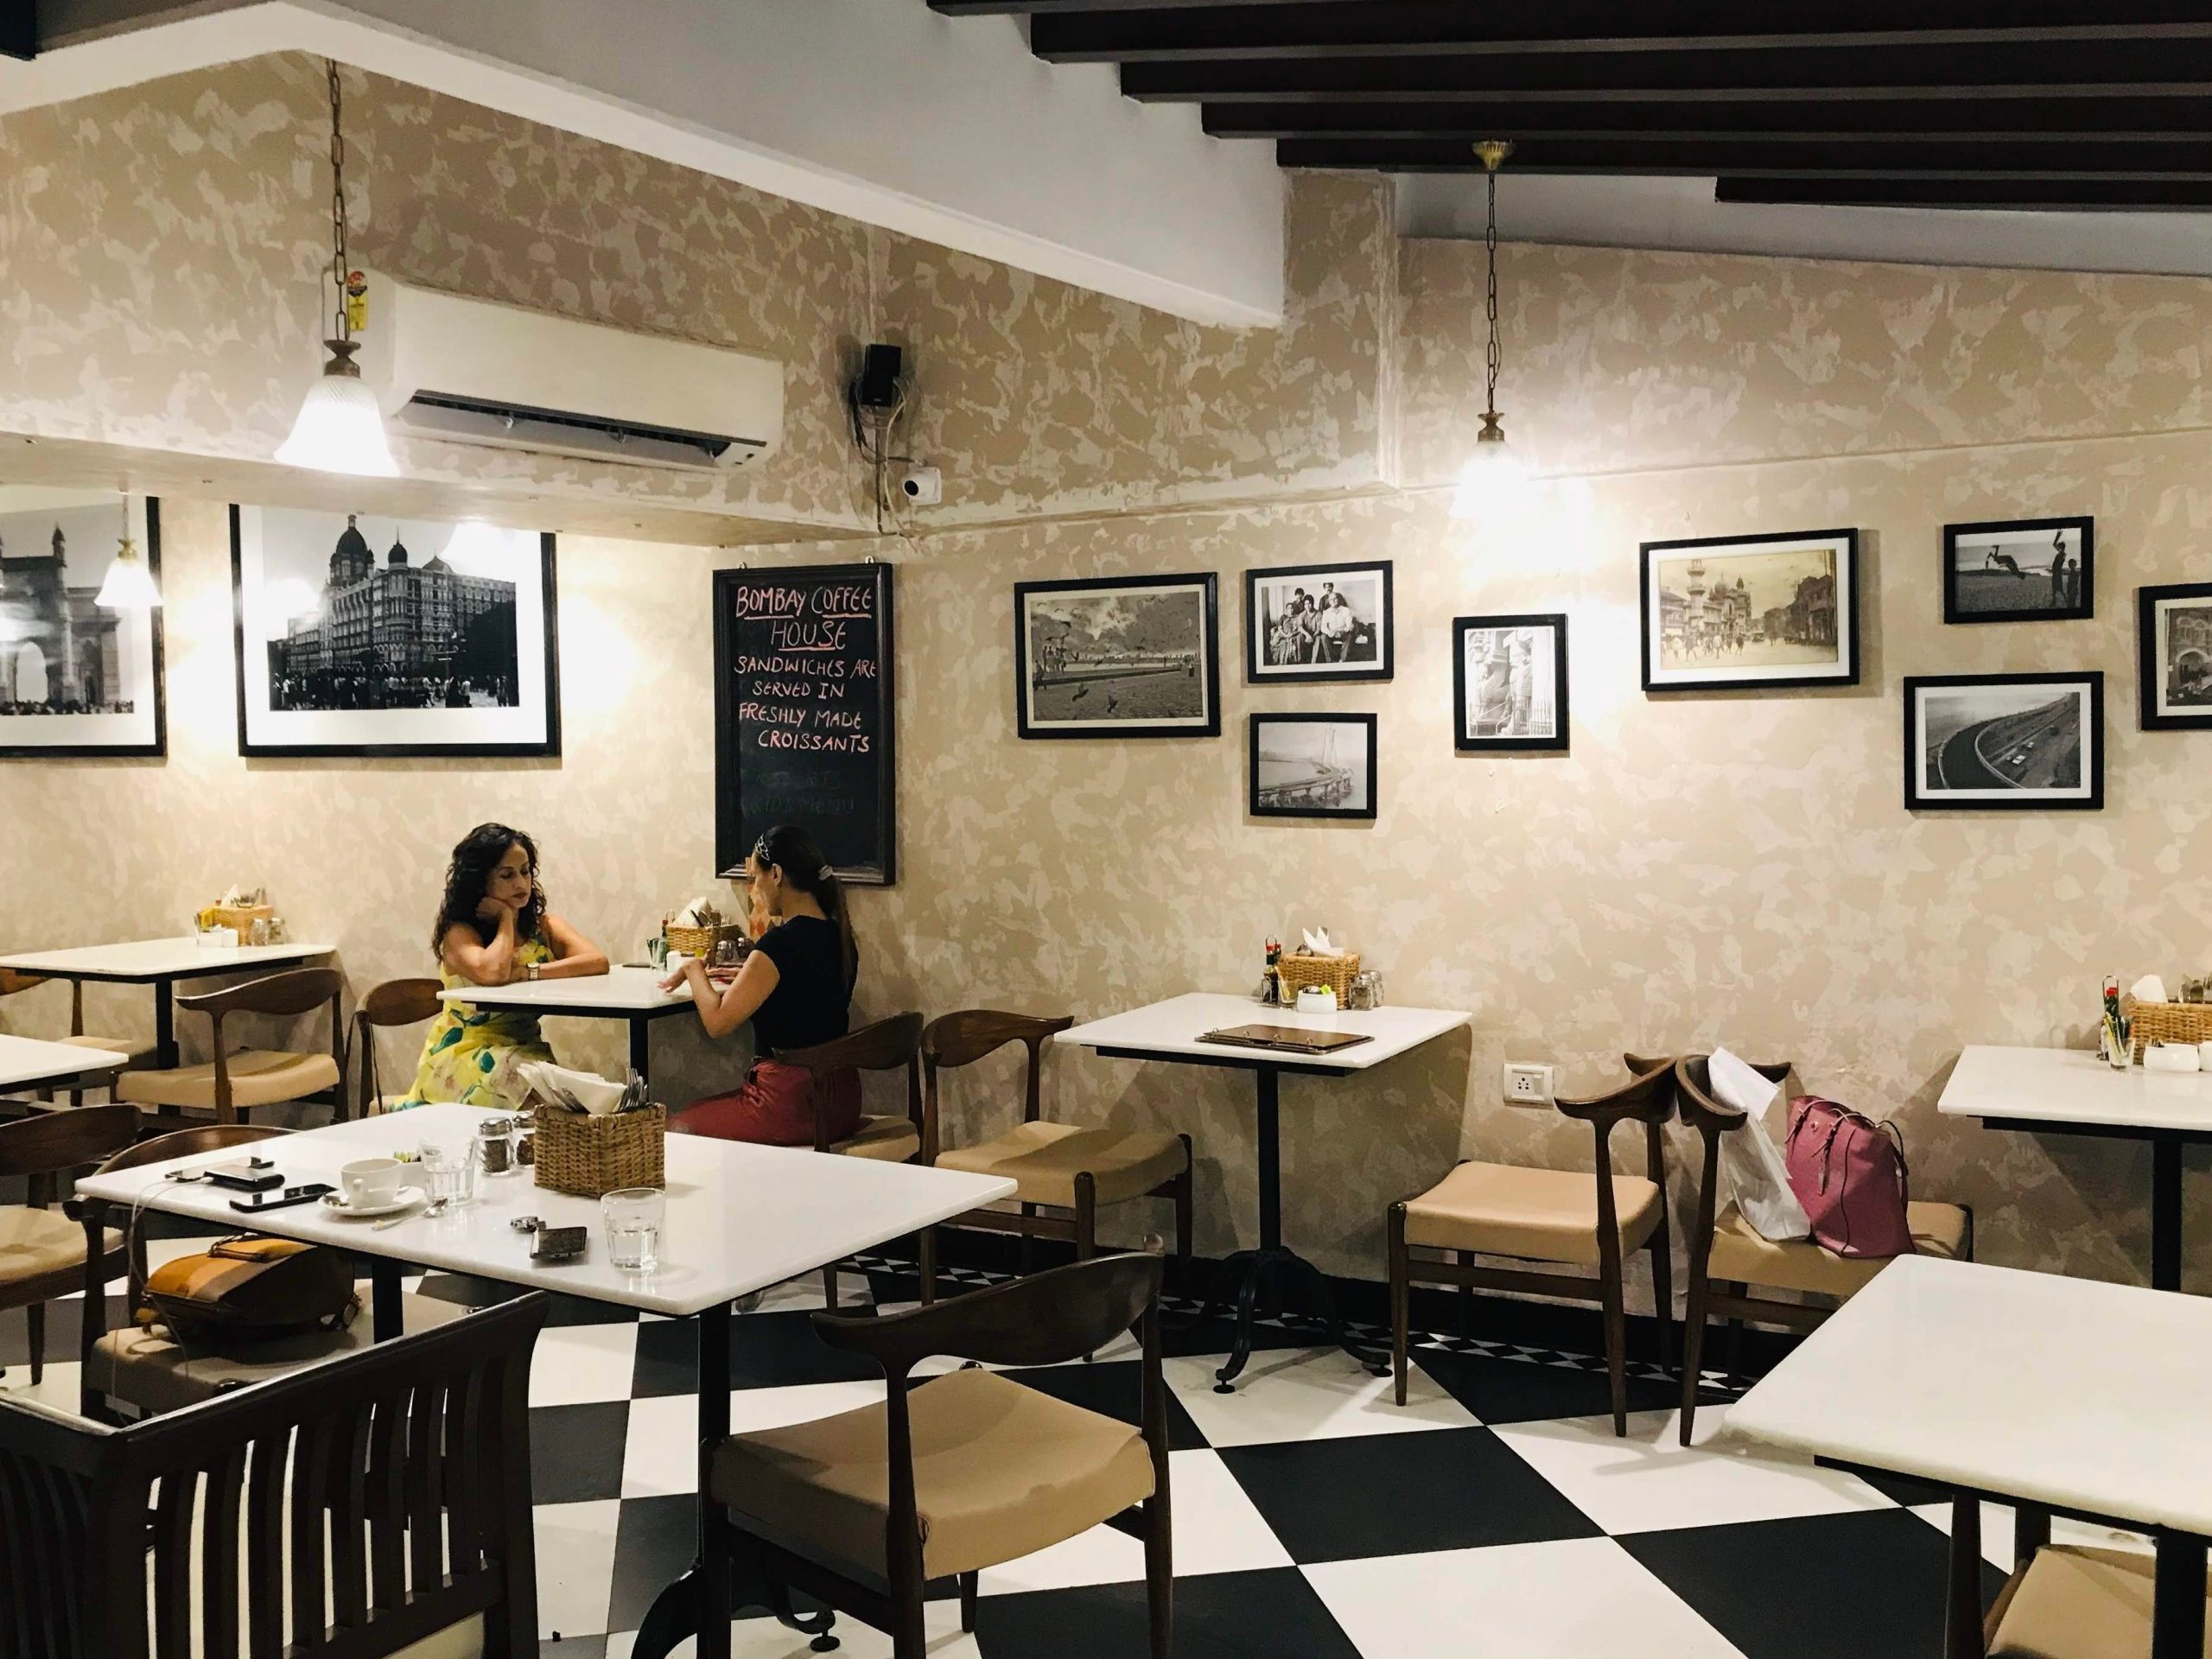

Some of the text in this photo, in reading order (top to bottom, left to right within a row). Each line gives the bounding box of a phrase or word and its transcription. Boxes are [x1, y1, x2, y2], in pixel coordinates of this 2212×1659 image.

[736, 586, 872, 617] BOMBAY COFFEE
[771, 620, 846, 650] HOUSE
[850, 658, 876, 679] ARE
[753, 681, 845, 699] SERVED IN
[739, 702, 862, 730] FRESHLY MADE
[758, 729, 869, 753] CROISSANTS
